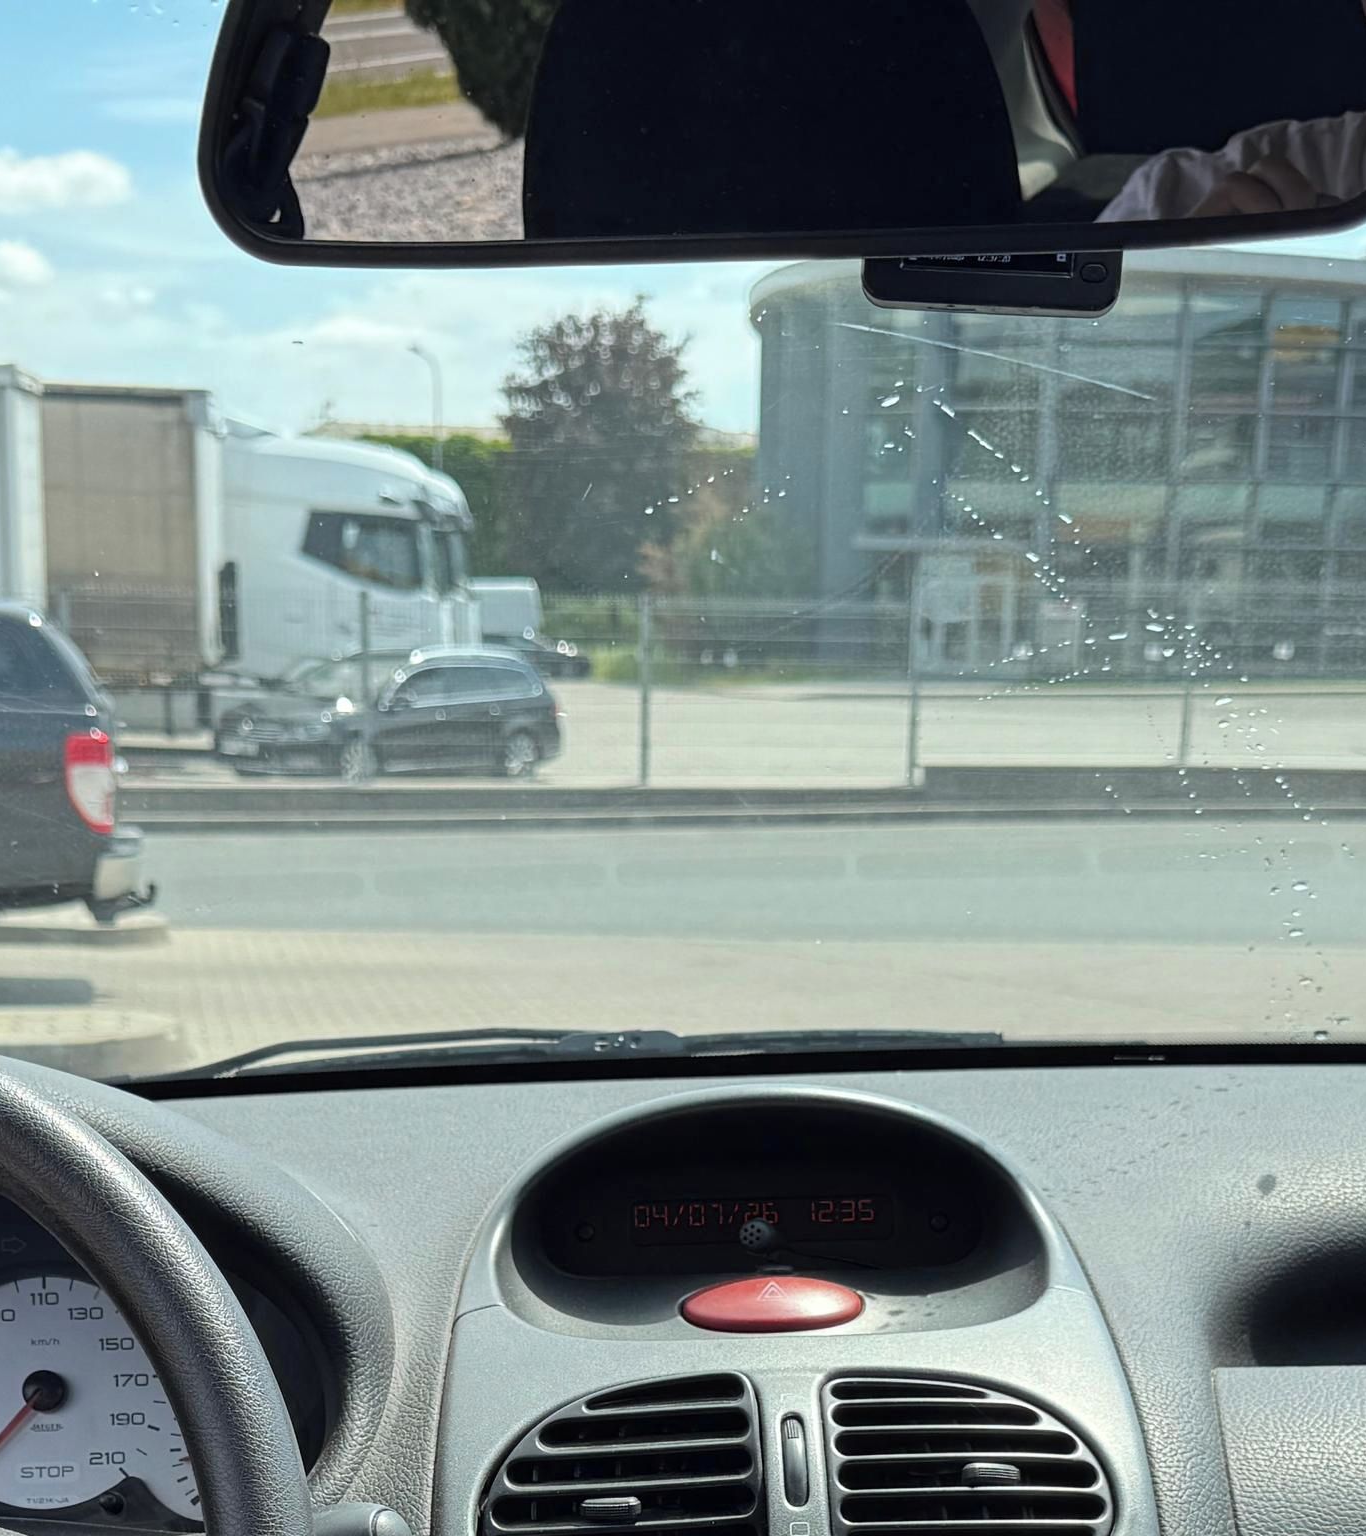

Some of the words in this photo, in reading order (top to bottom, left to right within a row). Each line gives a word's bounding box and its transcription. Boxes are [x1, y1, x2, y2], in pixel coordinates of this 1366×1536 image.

[634, 1202, 779, 1228] 04/07/26
[810, 1199, 875, 1222] 12:35
[30, 1292, 59, 1306] 110
[67, 1307, 104, 1320] 130
[30, 1337, 60, 1346] km/h
[98, 1337, 135, 1351] 150
[113, 1373, 149, 1388] 170
[109, 1412, 146, 1426] 190
[89, 1451, 126, 1465] 210
[20, 1465, 75, 1479] STOP
